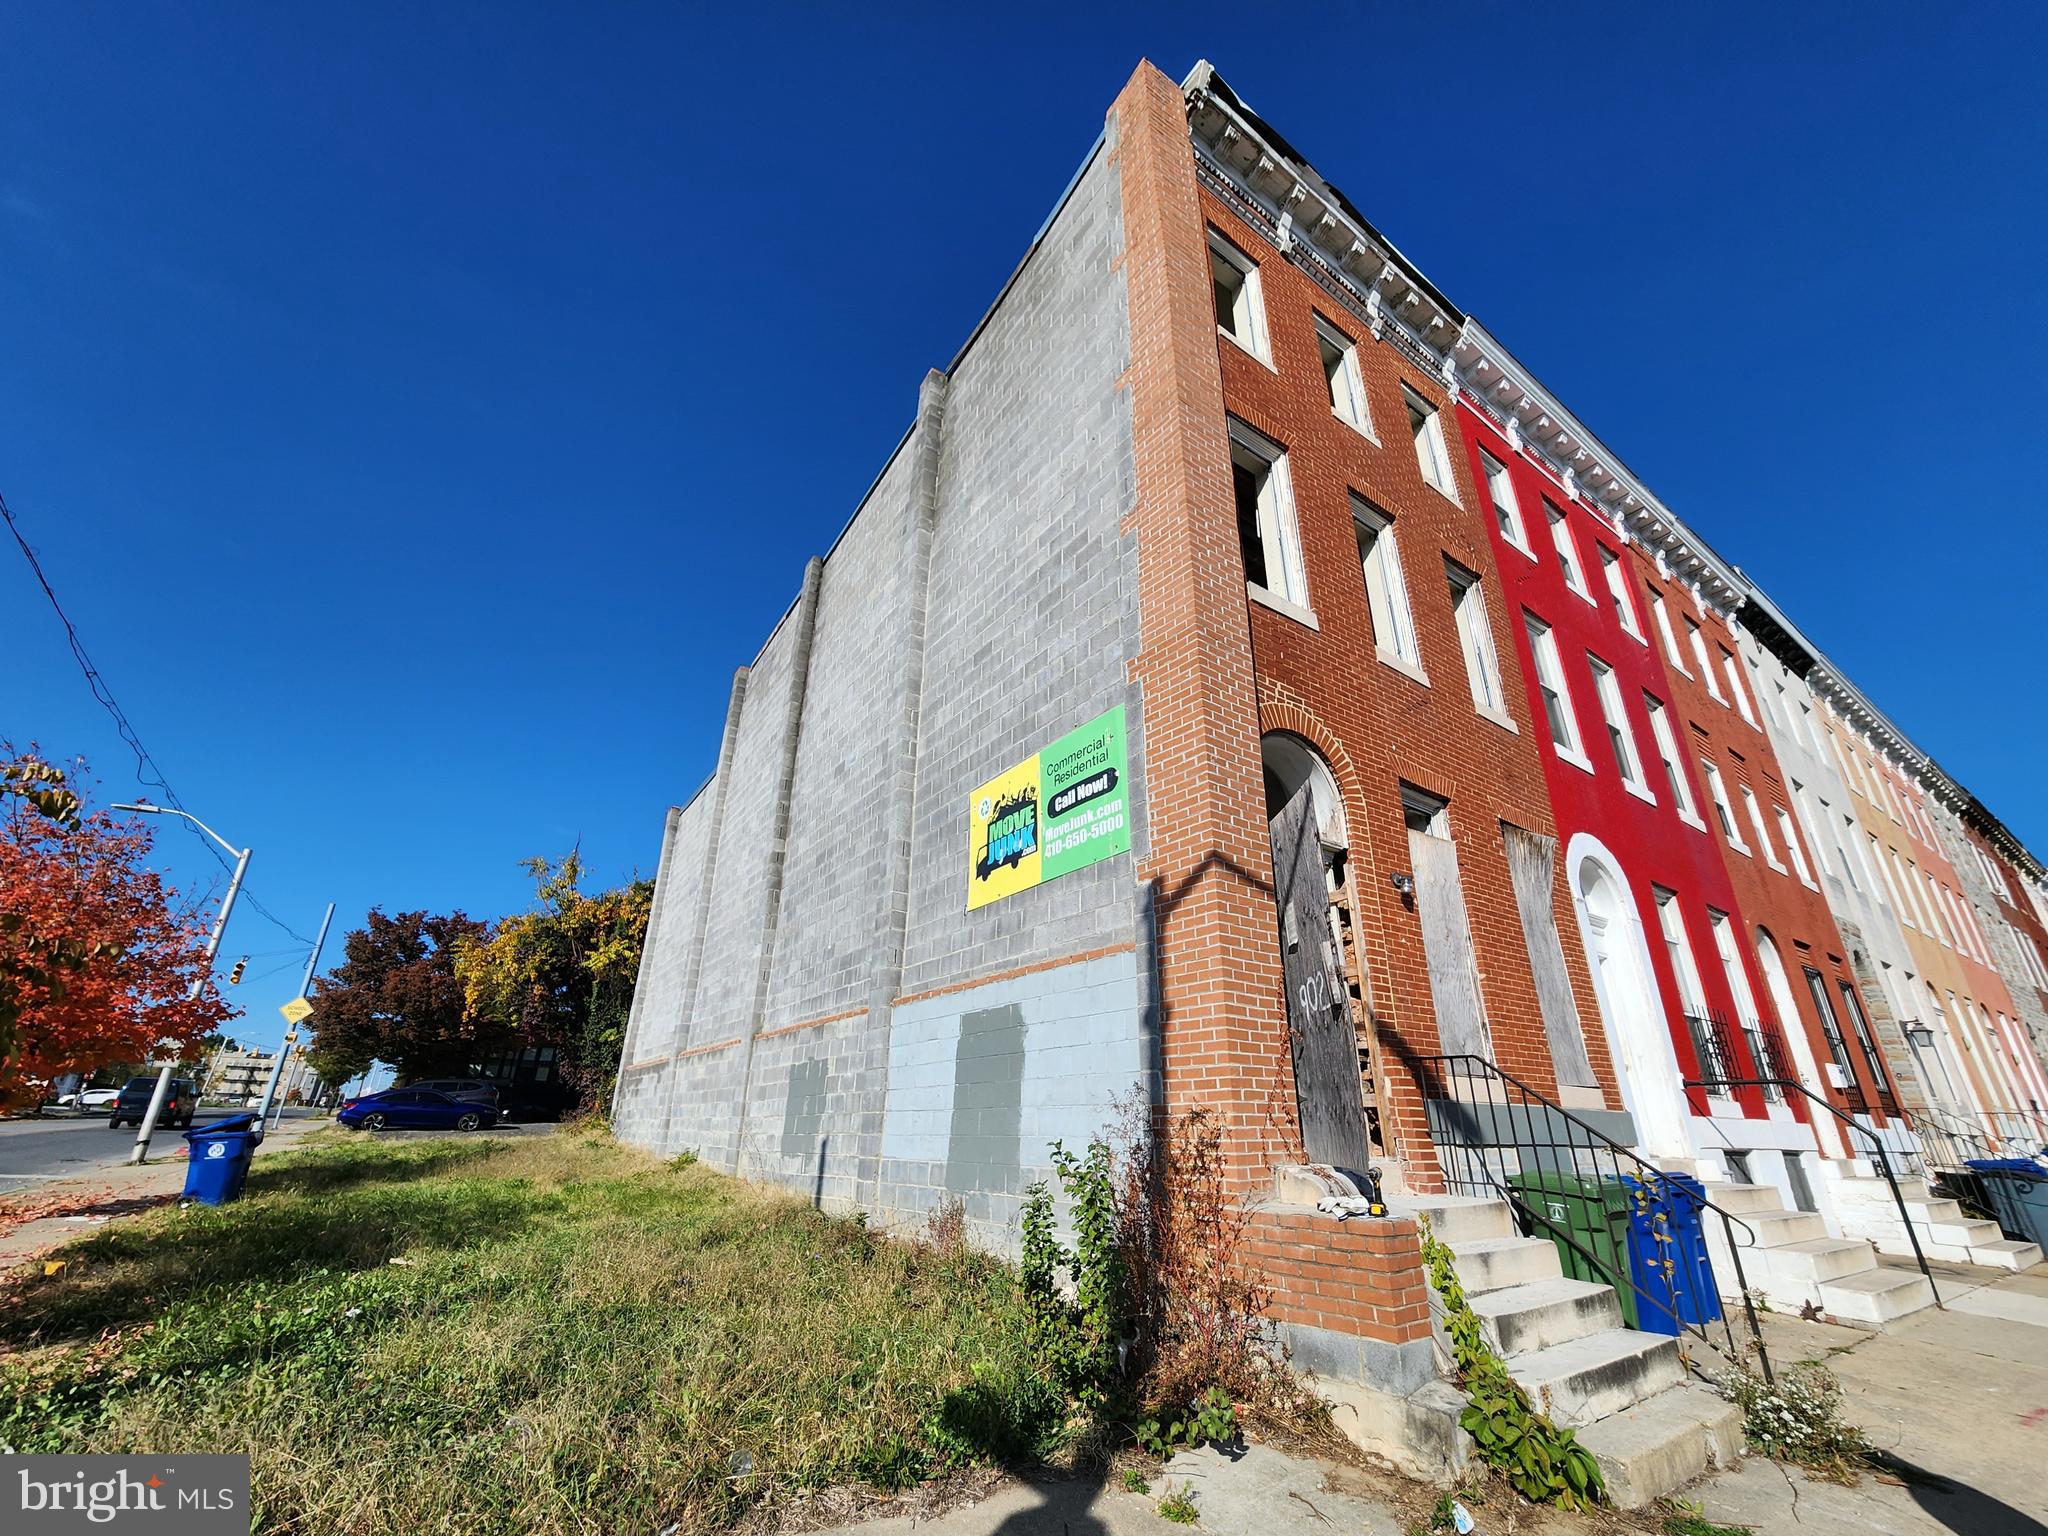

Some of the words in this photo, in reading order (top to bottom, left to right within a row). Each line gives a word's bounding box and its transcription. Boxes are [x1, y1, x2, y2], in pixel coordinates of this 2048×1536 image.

[1047, 734, 1105, 776] Commercial
[1054, 747, 1109, 787] Residential
[1054, 789, 1076, 812] Call
[1077, 773, 1108, 801] Now!
[989, 803, 1035, 844] MOVE
[1045, 799, 1122, 842] MoveJunk.com
[1045, 813, 1123, 858] 410-650-5000
[987, 823, 1035, 866] JUNK
[1299, 970, 1331, 1024] 902
